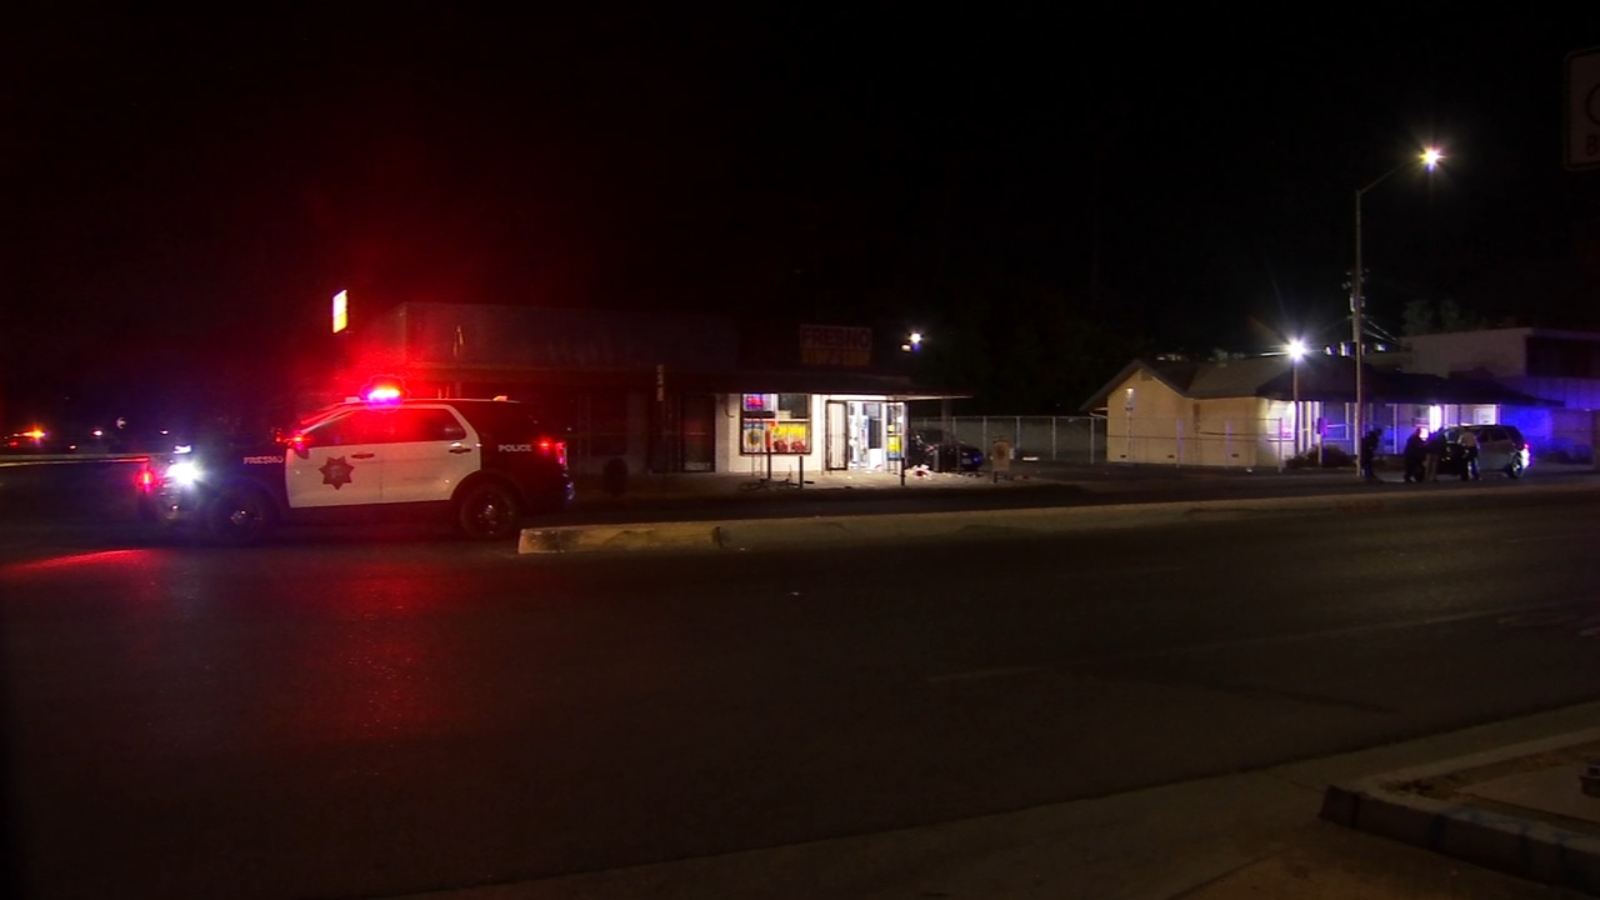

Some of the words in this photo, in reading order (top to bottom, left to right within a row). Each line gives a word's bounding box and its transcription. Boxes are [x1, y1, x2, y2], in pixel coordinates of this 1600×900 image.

[802, 327, 870, 348] FRESNO
[498, 443, 533, 453] POLICE
[243, 455, 285, 465] FRESNO
